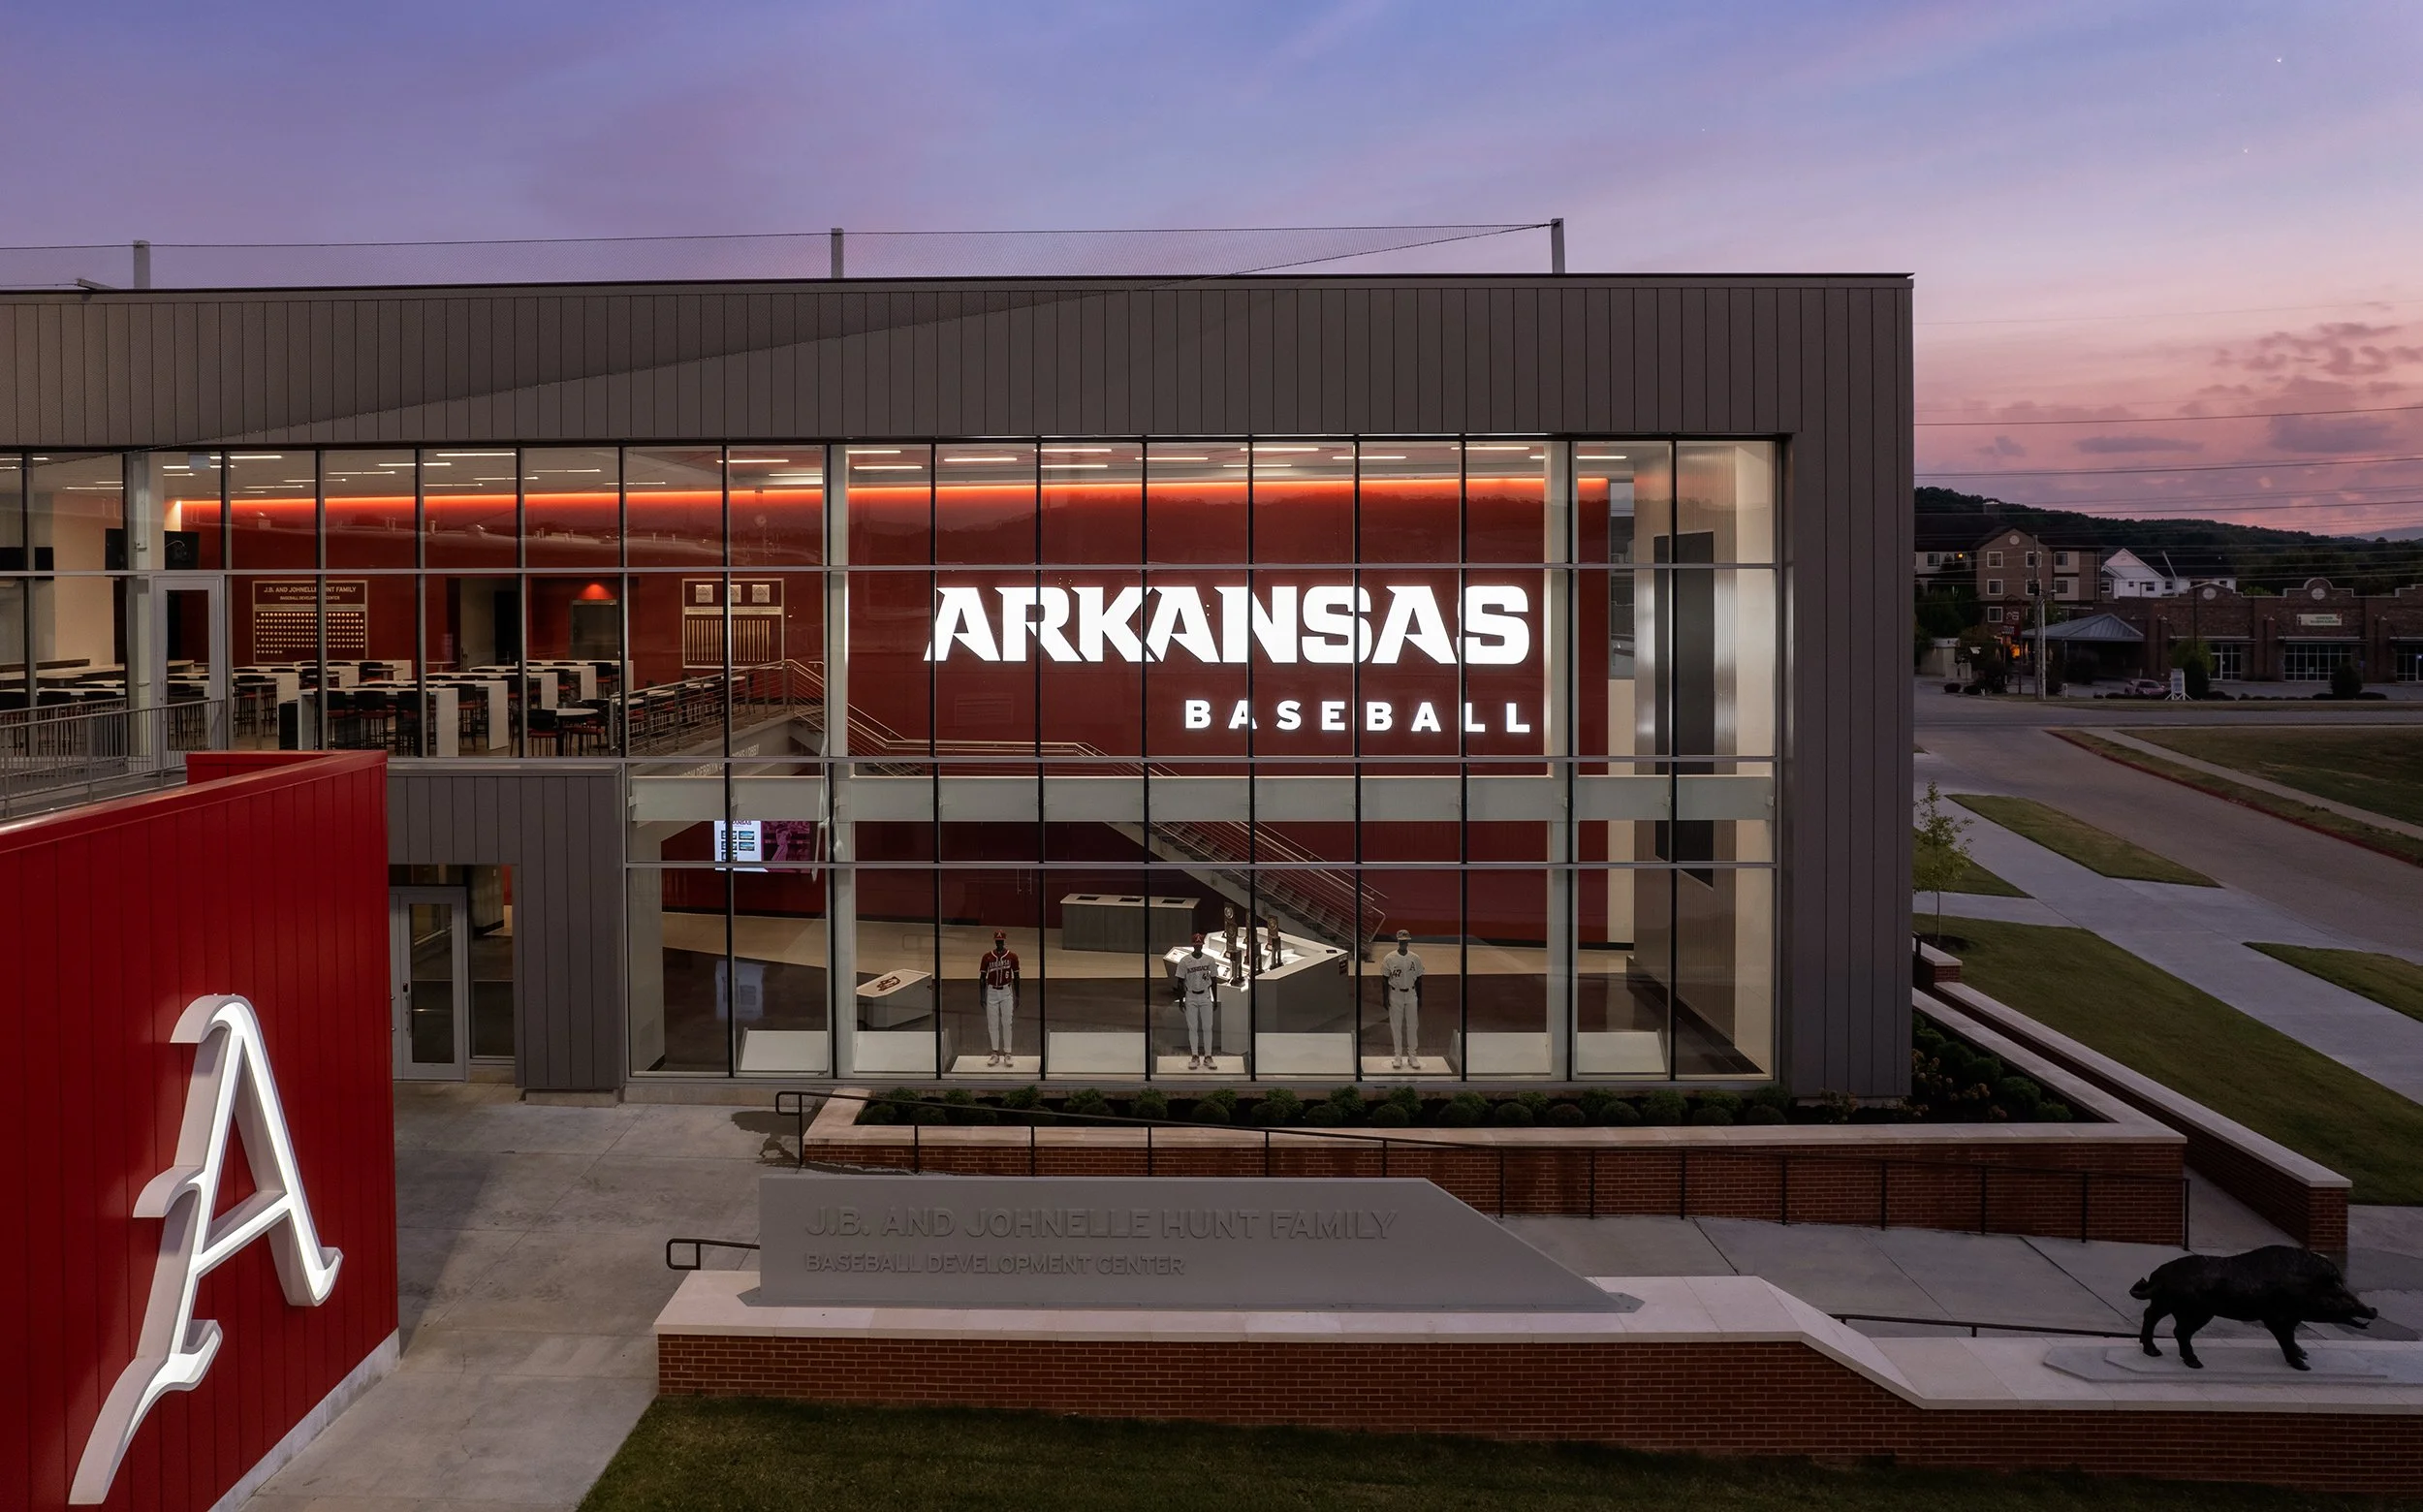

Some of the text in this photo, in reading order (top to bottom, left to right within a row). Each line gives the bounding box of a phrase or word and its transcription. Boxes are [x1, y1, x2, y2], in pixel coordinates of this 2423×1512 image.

[924, 586, 1529, 664] ARKANSAS
[1185, 700, 1530, 733] BASEBALL
[1409, 961, 1416, 971] A
[805, 1206, 1398, 1240] J.B. AND JOHNELLE HUNT FAMILY
[805, 1251, 1185, 1276] BASEBALL DEVELOPMENT CENTER
